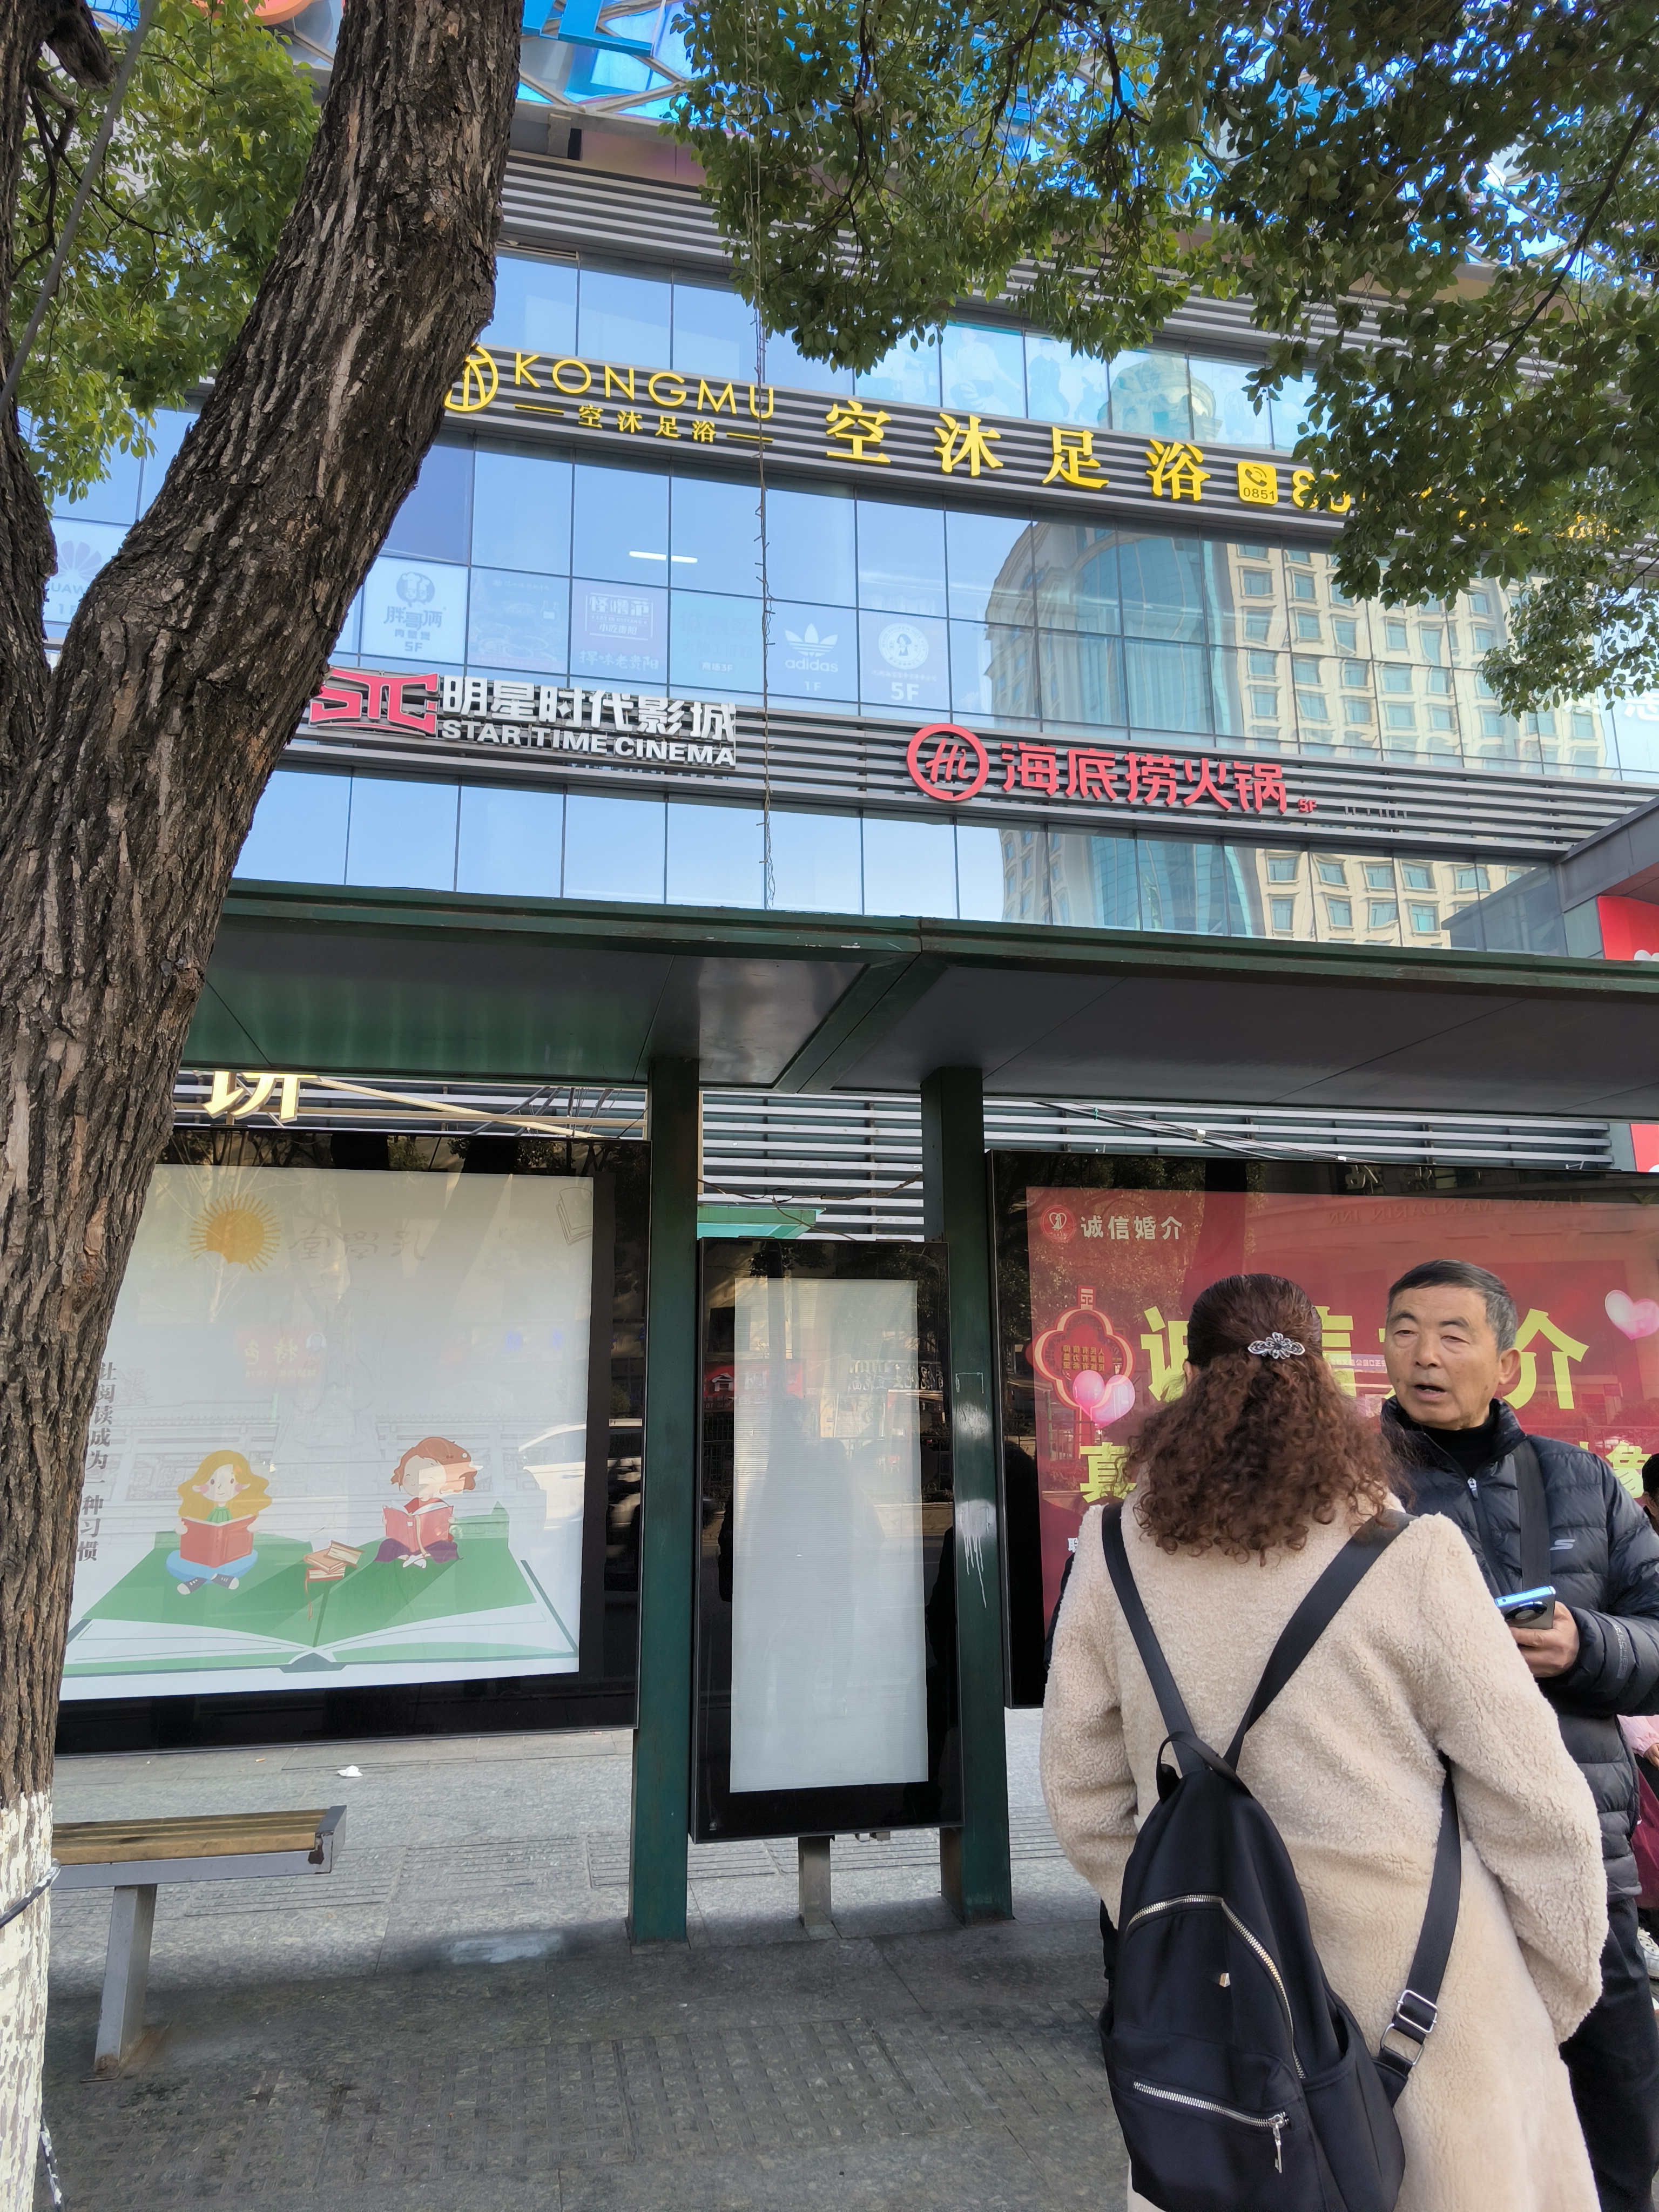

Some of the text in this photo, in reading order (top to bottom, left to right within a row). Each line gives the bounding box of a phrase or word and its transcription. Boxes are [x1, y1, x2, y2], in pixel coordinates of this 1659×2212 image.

[515, 352, 774, 419] KONGMU
[578, 403, 717, 443] 空沐足浴
[825, 400, 1212, 501] 空沐足浴
[1243, 487, 1275, 501] 0851
[383, 605, 443, 630] 胖哥俩
[599, 623, 638, 636] 小吃贵阳
[404, 641, 423, 652] 5F
[702, 661, 733, 672] 商场3F
[785, 657, 839, 673] adidas
[891, 682, 920, 702] 5F
[442, 675, 737, 743] 明星时代影城
[442, 719, 737, 767] STAR TIME CINEMA
[999, 740, 1317, 815] 海底捞火锅 5F
[1081, 1215, 1183, 1241] 诚信婚介
[77, 1362, 117, 1562] 让阅读成为一种习惯
